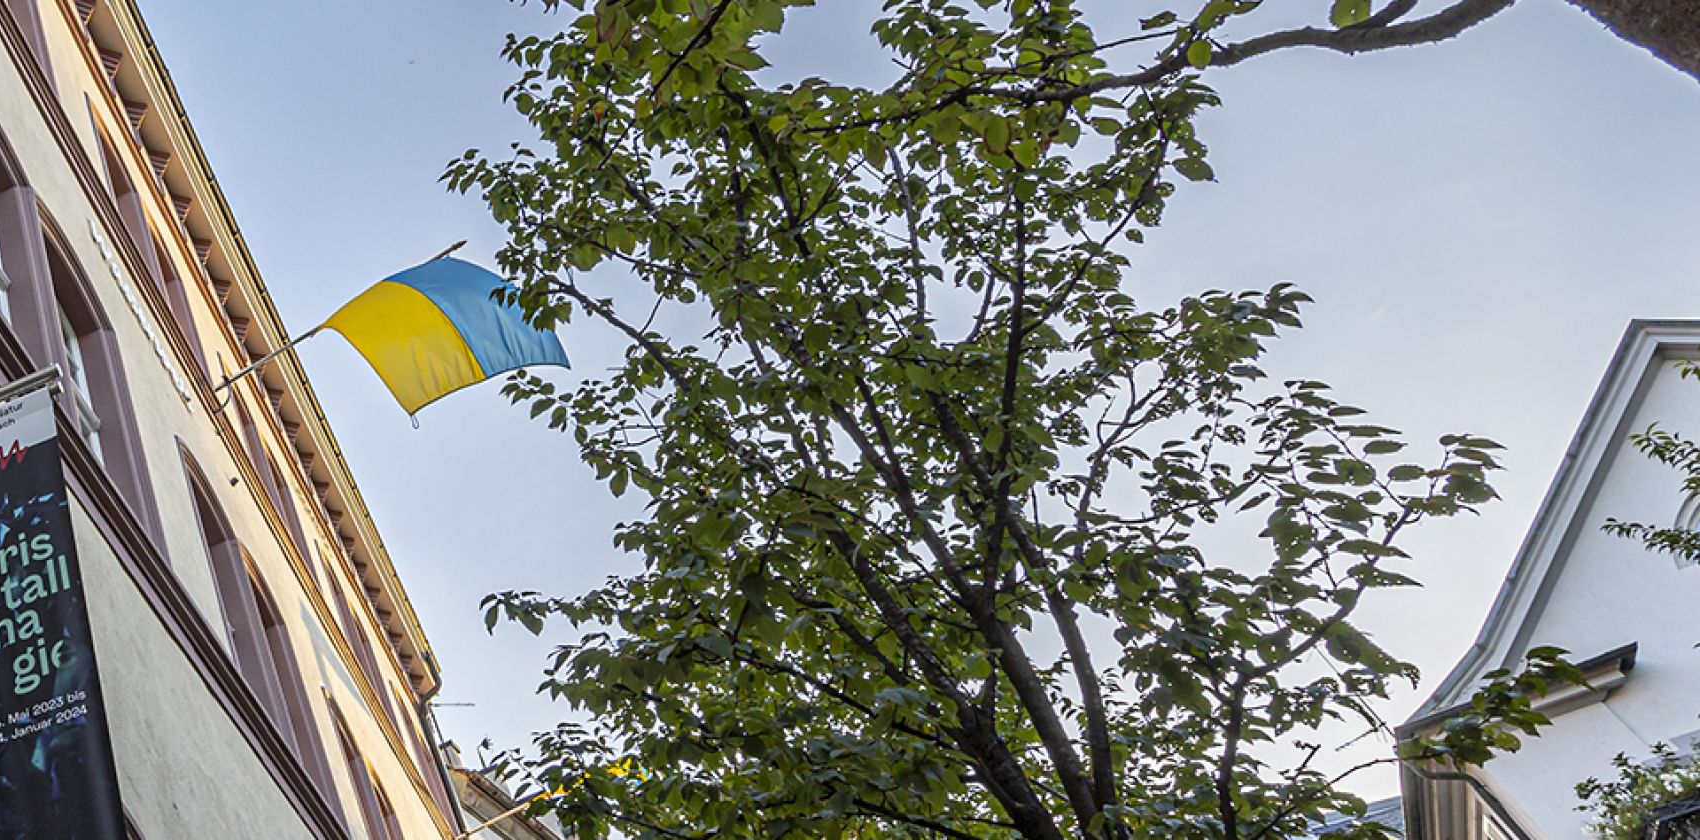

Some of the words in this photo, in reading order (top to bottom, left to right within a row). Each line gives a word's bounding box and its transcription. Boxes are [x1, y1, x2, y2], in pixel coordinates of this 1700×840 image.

[0, 554, 70, 610] tall
[8, 708, 30, 724] Mai
[33, 696, 64, 717] 2023
[66, 690, 87, 703] bis
[11, 717, 53, 740] Januar
[56, 704, 87, 724] 2024
